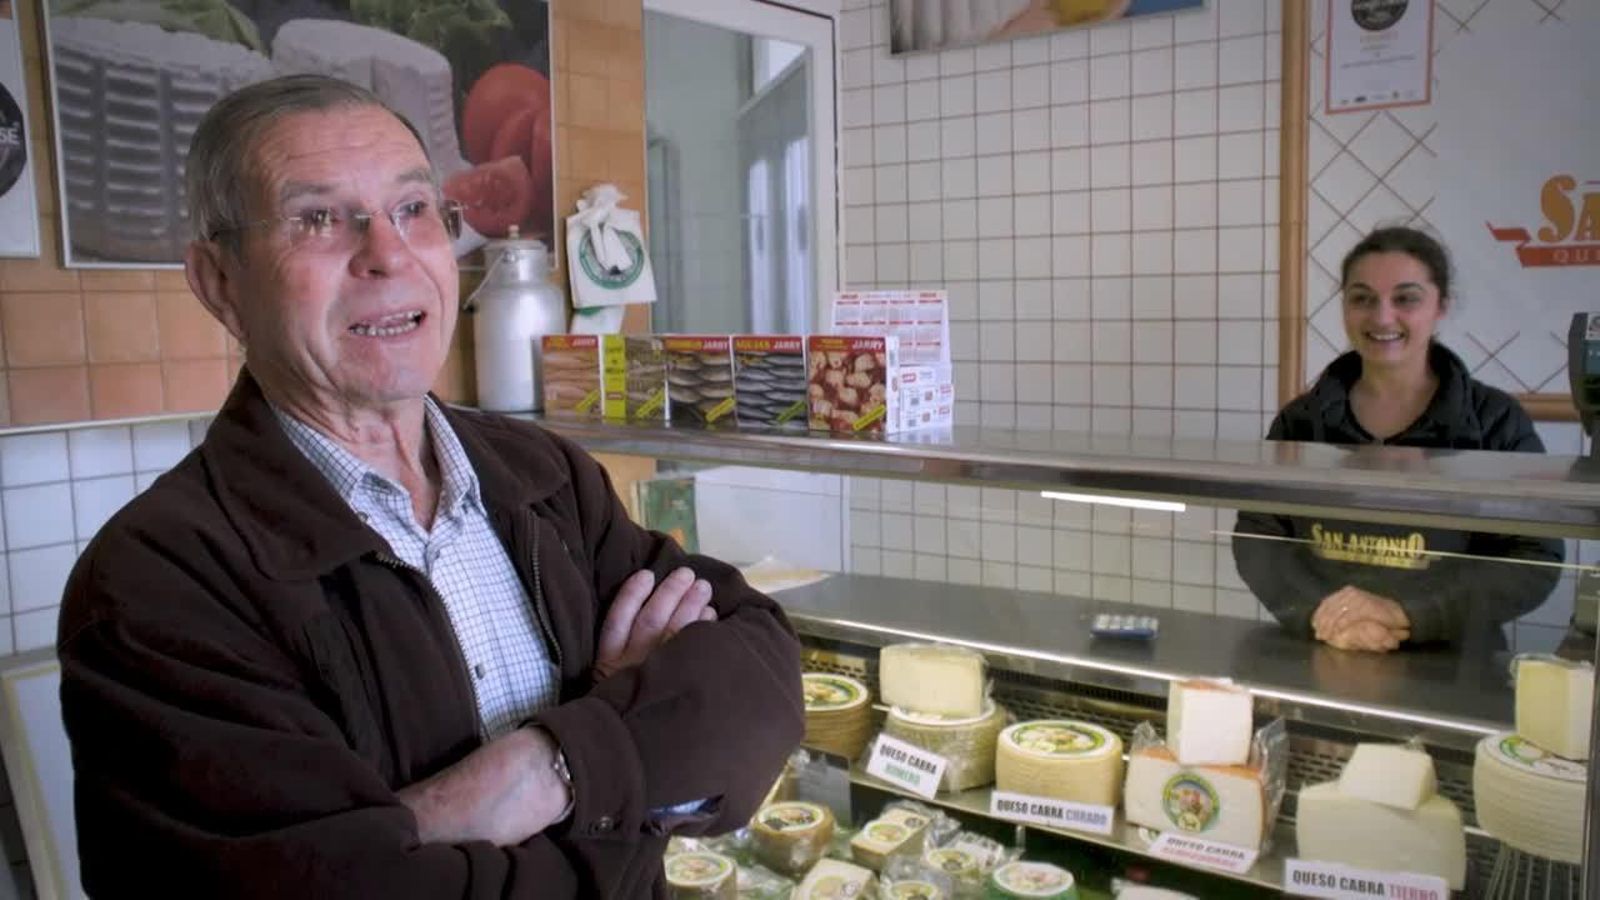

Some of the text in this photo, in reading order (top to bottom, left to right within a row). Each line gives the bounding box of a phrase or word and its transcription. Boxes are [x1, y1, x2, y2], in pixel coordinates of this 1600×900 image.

[773, 340, 801, 351] JARRY
[852, 339, 884, 352] JARRY
[880, 743, 937, 775] QUESO CABRA
[997, 799, 1028, 814] QUESO
[1030, 804, 1063, 820] CABRA
[1293, 869, 1336, 889] QUESO
[1339, 876, 1386, 897] CABRA
